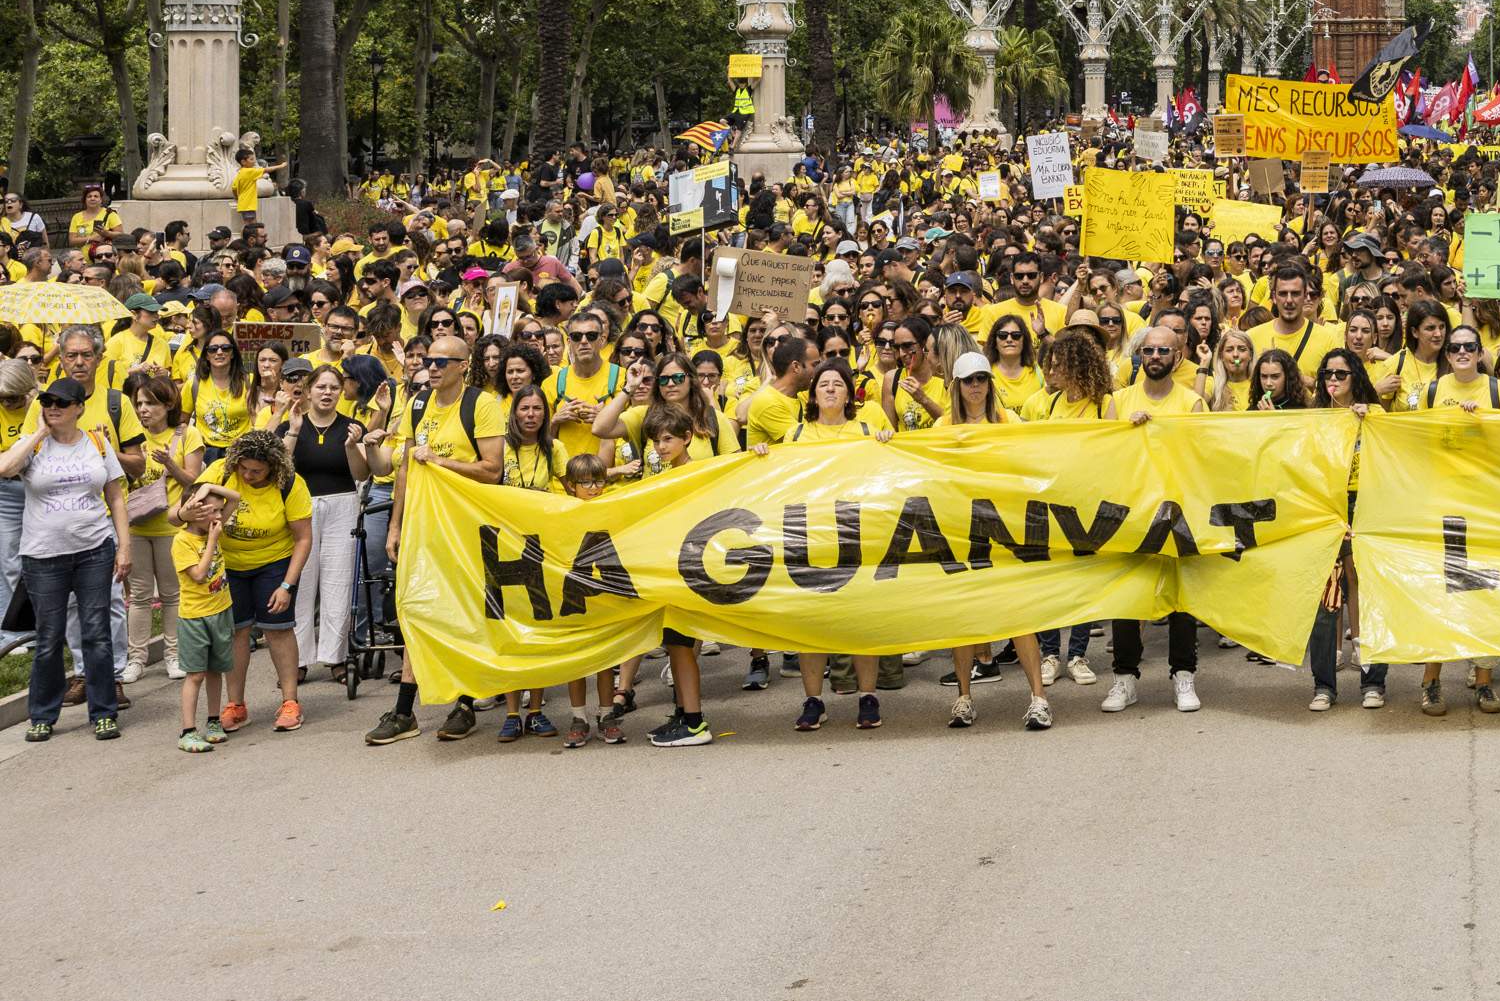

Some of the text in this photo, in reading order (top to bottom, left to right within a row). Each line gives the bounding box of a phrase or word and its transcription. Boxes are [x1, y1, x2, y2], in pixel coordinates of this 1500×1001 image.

[1237, 82, 1280, 113] MÉS
[1290, 89, 1381, 118] RECURSOS
[1245, 125, 1287, 155] ENYS
[1067, 188, 1082, 197] EL
[1069, 200, 1083, 210] EX
[741, 252, 760, 267] QUE
[761, 261, 789, 270] AQUEST
[771, 276, 797, 287] PAPER
[736, 287, 794, 298] IMPRESCINDIBLE
[736, 302, 743, 310] A
[478, 496, 1276, 622] HA GUANYAT
